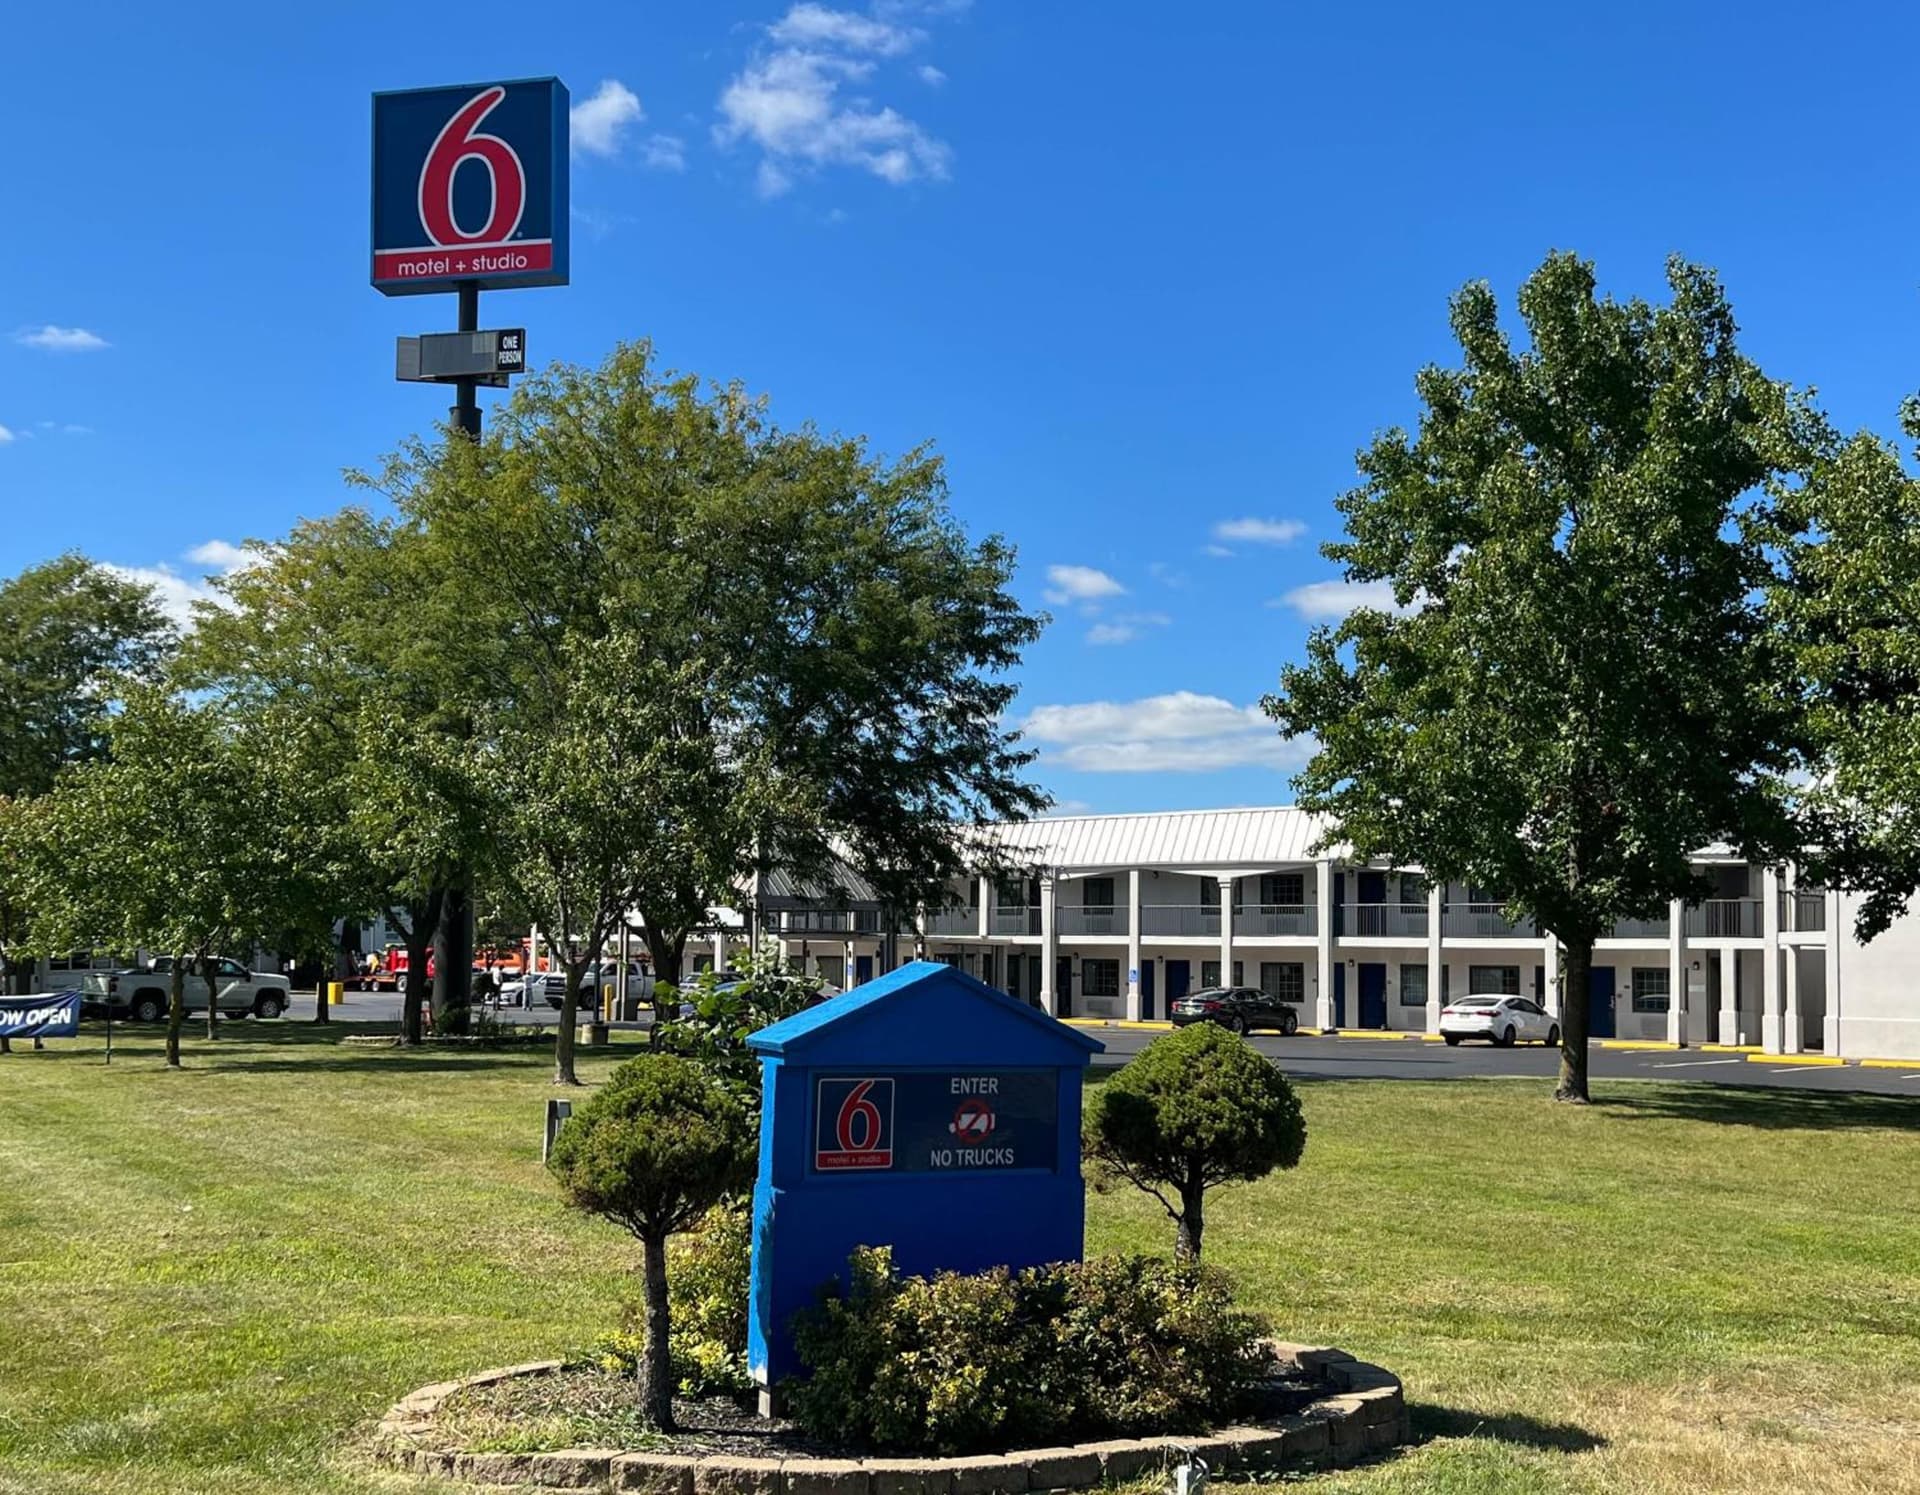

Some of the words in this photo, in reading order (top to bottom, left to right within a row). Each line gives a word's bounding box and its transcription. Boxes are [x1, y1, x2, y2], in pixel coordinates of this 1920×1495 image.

[418, 86, 526, 247] 6
[398, 258, 450, 276] motel
[472, 252, 527, 271] studio
[502, 335, 518, 349] ONE
[498, 350, 522, 364] PERSON
[0, 1009, 24, 1026] OW
[26, 1007, 72, 1026] OPEN
[950, 1077, 999, 1094] ENTER
[836, 1079, 881, 1152] 6
[930, 1149, 952, 1167] NO
[955, 1147, 1014, 1166] TRUCKS
